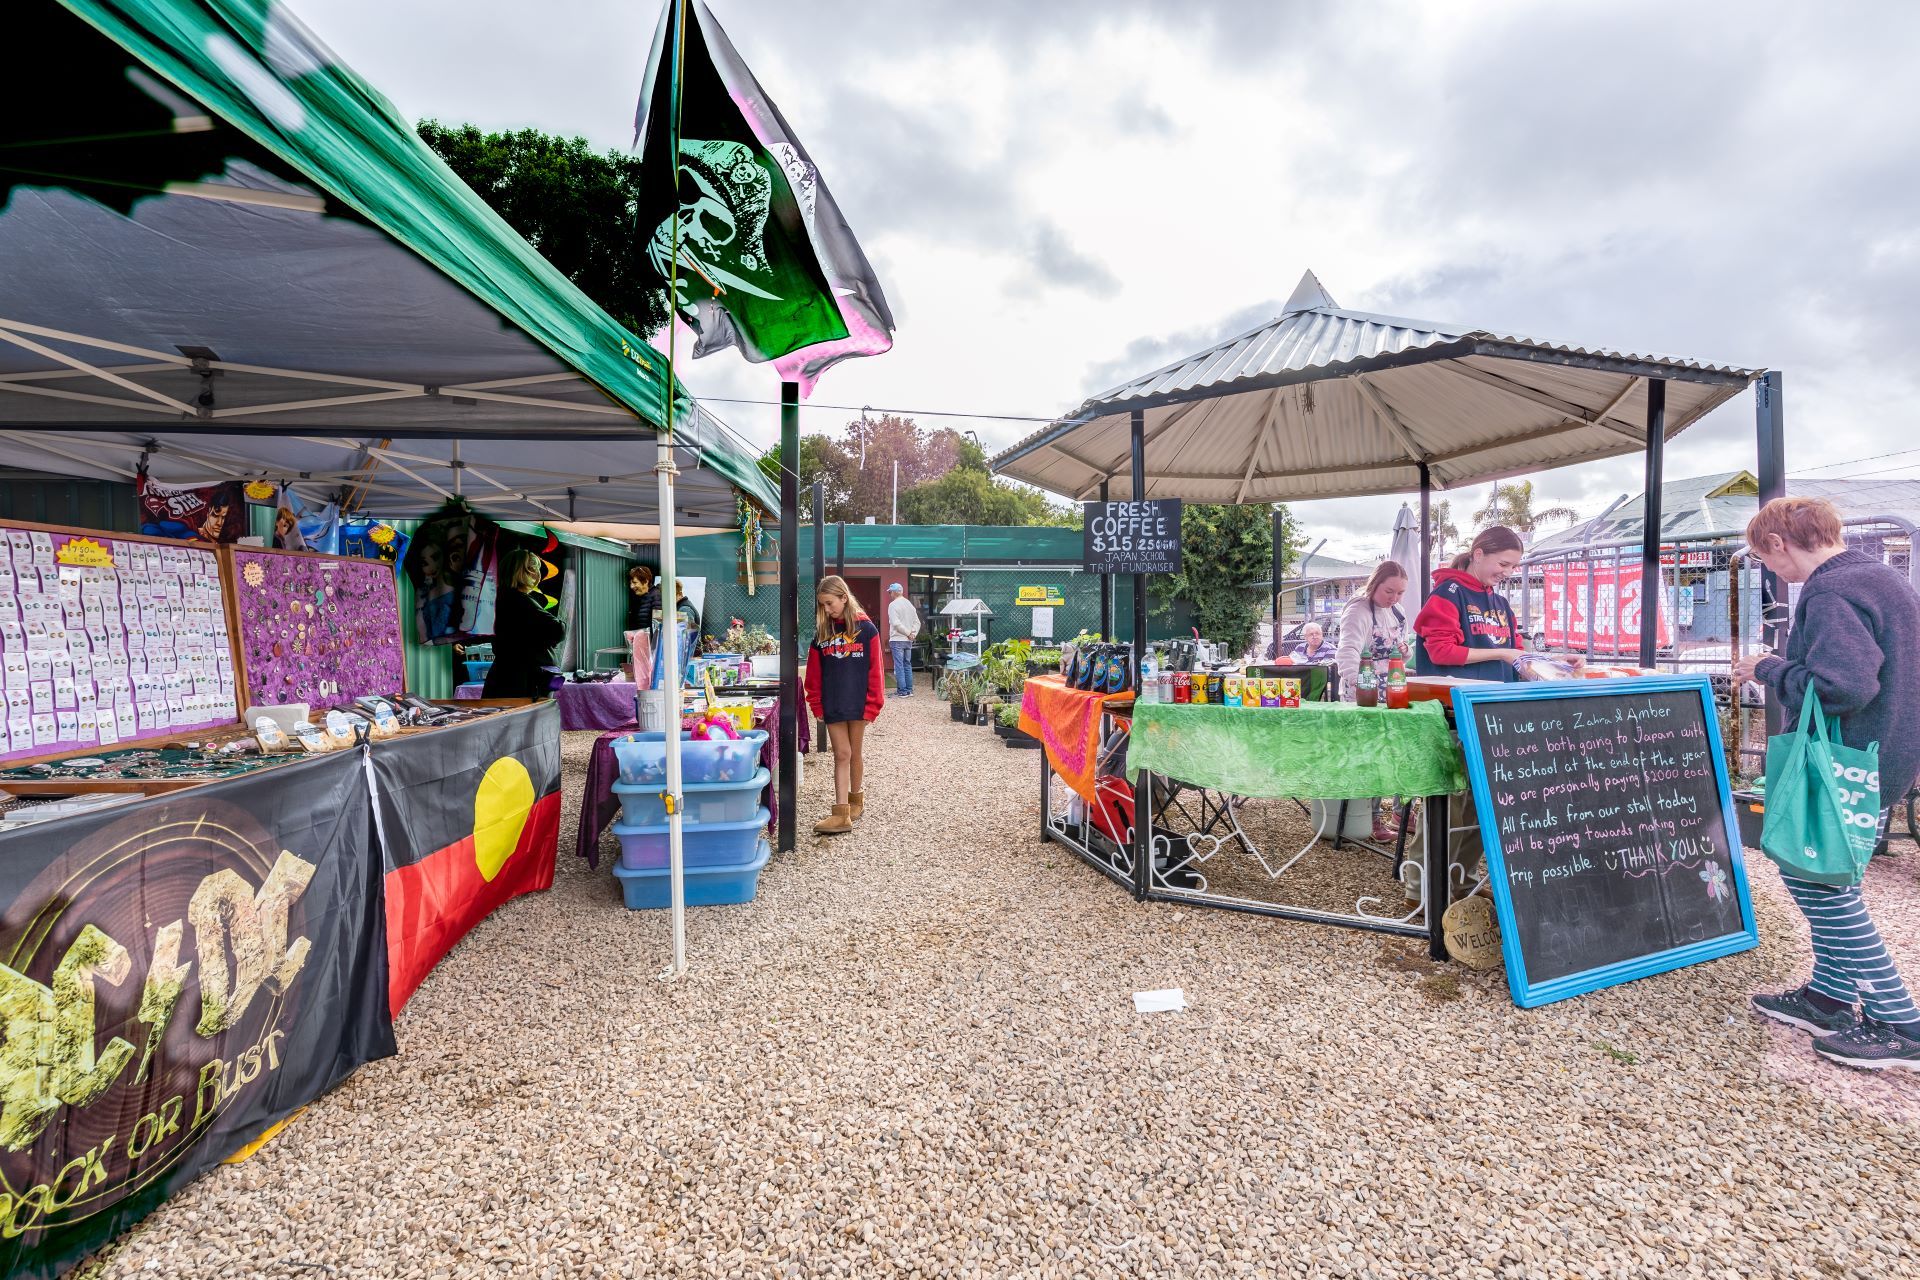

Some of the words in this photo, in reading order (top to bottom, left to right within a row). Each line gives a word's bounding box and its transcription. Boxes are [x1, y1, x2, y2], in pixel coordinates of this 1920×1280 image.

[1106, 500, 1161, 517] FRESH
[1091, 516, 1168, 537] COFFEE
[1092, 536, 1132, 552] $15
[1105, 552, 1138, 563] JAPAN
[1140, 551, 1167, 561] SCHOOL
[1090, 563, 1114, 573] TRIP
[1121, 562, 1174, 573] FUNDRAISER
[1484, 713, 1503, 736] Hi
[1513, 720, 1535, 734] we
[1541, 717, 1564, 732] are
[1573, 712, 1612, 730] Zahra
[1627, 699, 1671, 722] Amber
[1516, 744, 1539, 756] are
[1546, 737, 1576, 753] both
[1579, 738, 1614, 757] going
[1616, 729, 1628, 744] to
[1634, 726, 1675, 744] Japan
[1680, 721, 1705, 738] with
[1492, 762, 1514, 782] the
[1518, 757, 1558, 779] school
[1564, 759, 1579, 773] at
[1585, 755, 1606, 771] the
[1610, 754, 1630, 769] end
[1632, 751, 1647, 770] of
[1650, 750, 1676, 766] the
[1682, 751, 1706, 768] year
[1520, 789, 1537, 801] are
[1543, 773, 1600, 801] personally
[1604, 773, 1640, 793] paying
[1644, 769, 1679, 785] $2000
[1684, 765, 1711, 779] each
[1838, 788, 1866, 806] or
[1501, 816, 1515, 836] All
[1520, 809, 1558, 831] funds
[1566, 803, 1594, 823] from
[1599, 806, 1621, 818] our
[1627, 796, 1652, 815] stall
[1657, 788, 1697, 814] today
[1504, 839, 1524, 856] will
[1530, 836, 1544, 850] be
[1548, 831, 1580, 855] going
[1584, 821, 1633, 840] towards
[1681, 817, 1703, 828] our
[1509, 863, 1534, 888] trip
[1617, 841, 1668, 869] THANK
[1669, 838, 1699, 861] YOU
[1452, 927, 1503, 951] WELCO
[127, 1096, 182, 1160] OR
[190, 1030, 284, 1131] BUST
